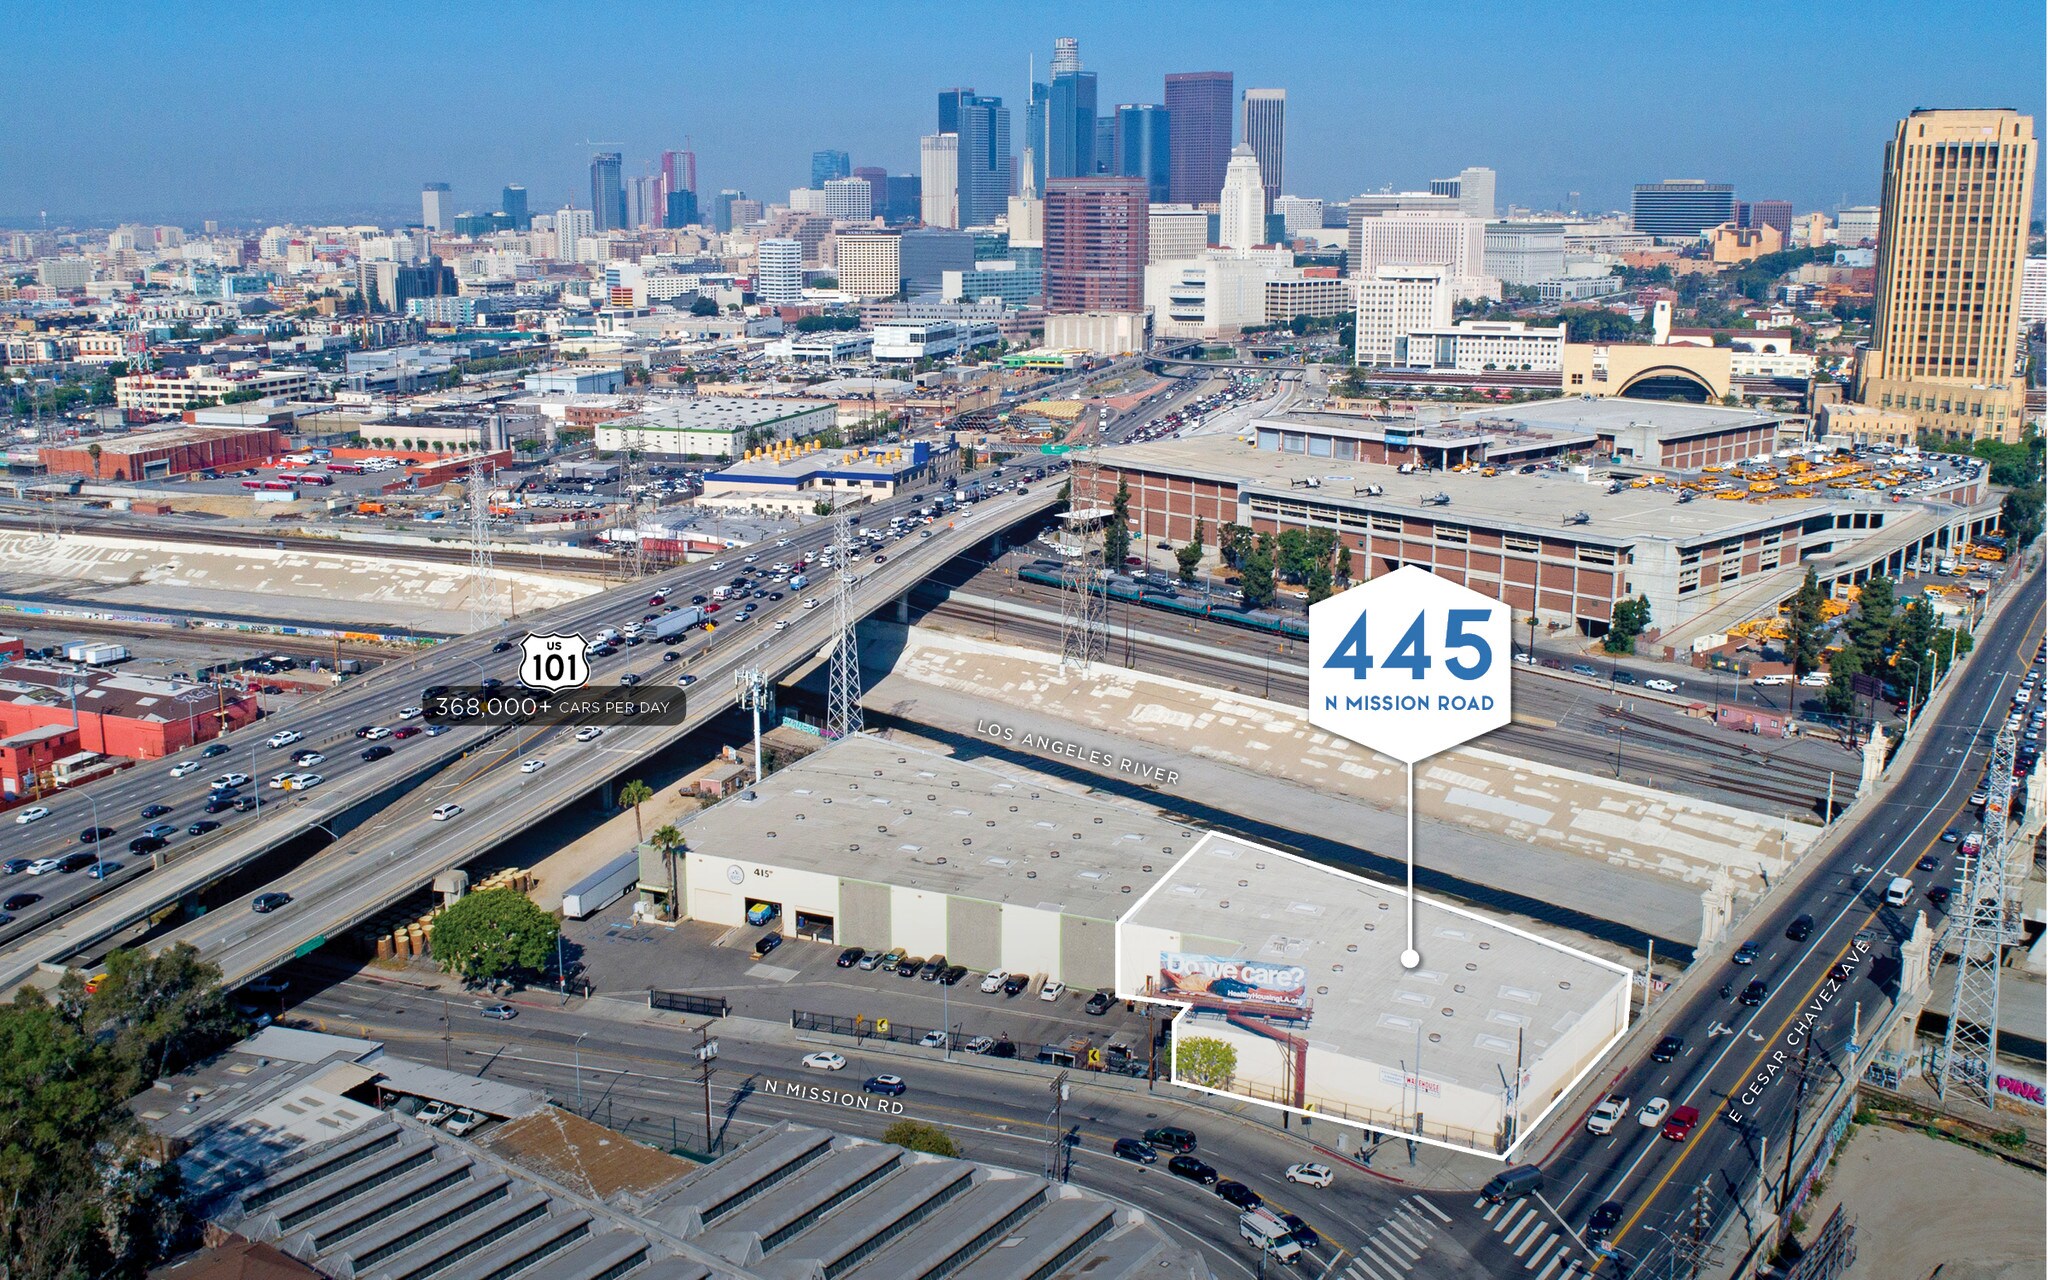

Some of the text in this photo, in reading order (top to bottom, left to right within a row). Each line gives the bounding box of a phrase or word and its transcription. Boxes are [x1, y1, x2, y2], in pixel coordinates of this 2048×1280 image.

[1168, 953, 1305, 988] Do we care?
[1227, 989, 1303, 1006] HealthyHousingLA.org
[1406, 1077, 1440, 1093] WAEHOUSE
